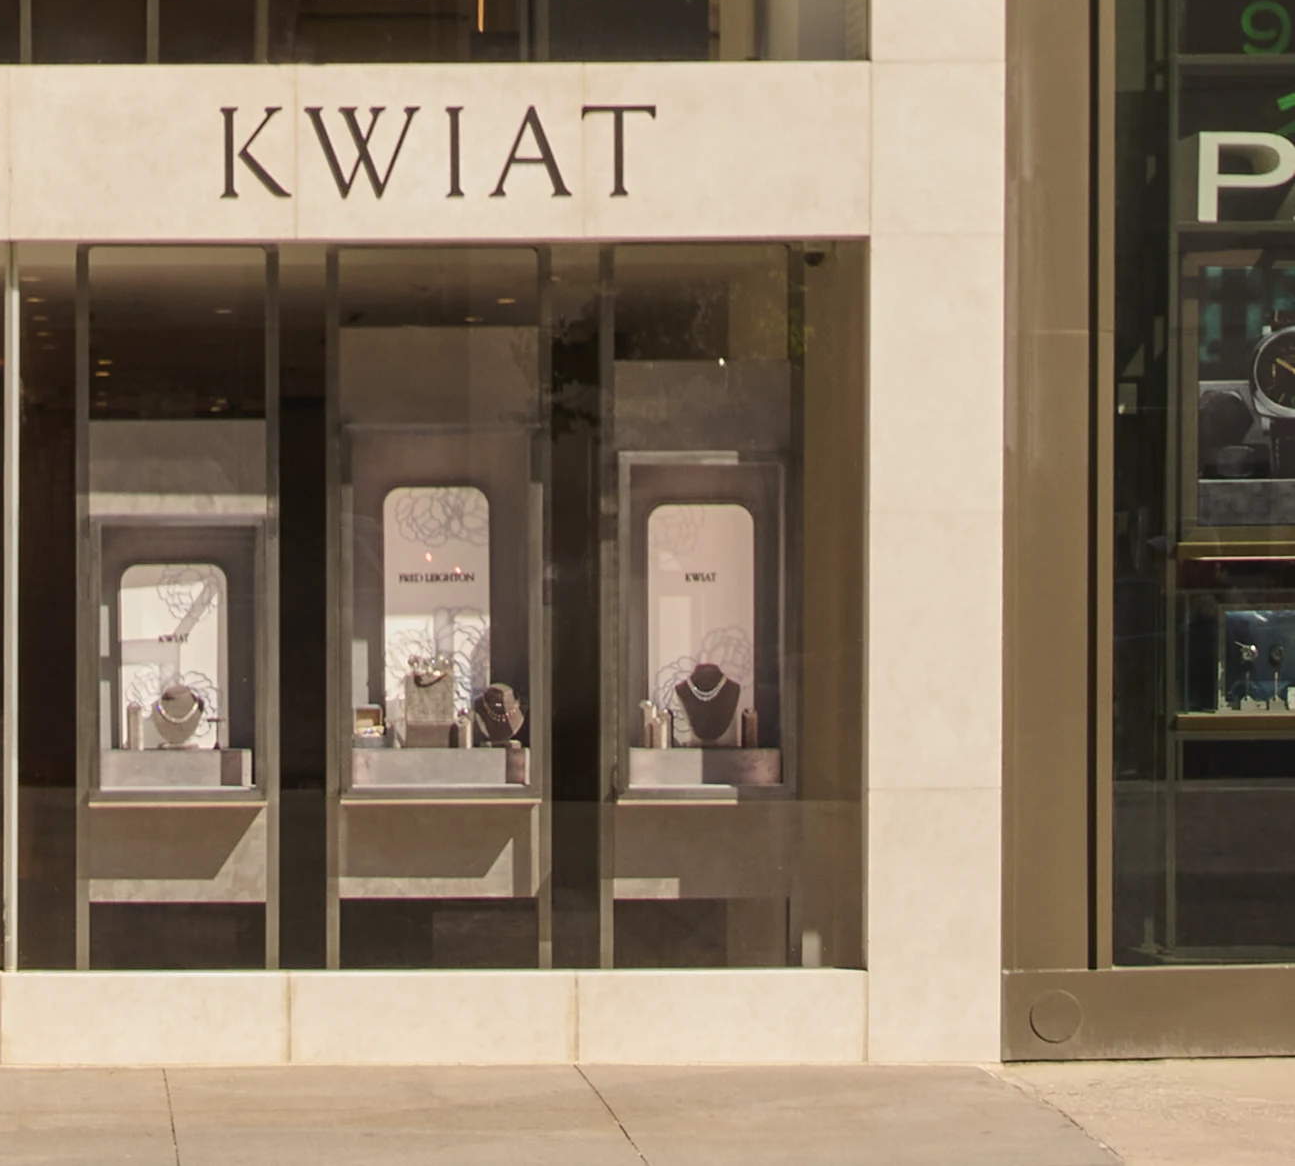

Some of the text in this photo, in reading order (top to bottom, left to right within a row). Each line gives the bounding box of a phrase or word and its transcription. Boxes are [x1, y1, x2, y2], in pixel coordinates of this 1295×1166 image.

[220, 105, 657, 199] KWIAT
[399, 573, 475, 583] FRED LEIGHTON
[685, 572, 717, 583] KWIAT
[158, 633, 189, 643] KWIAT
